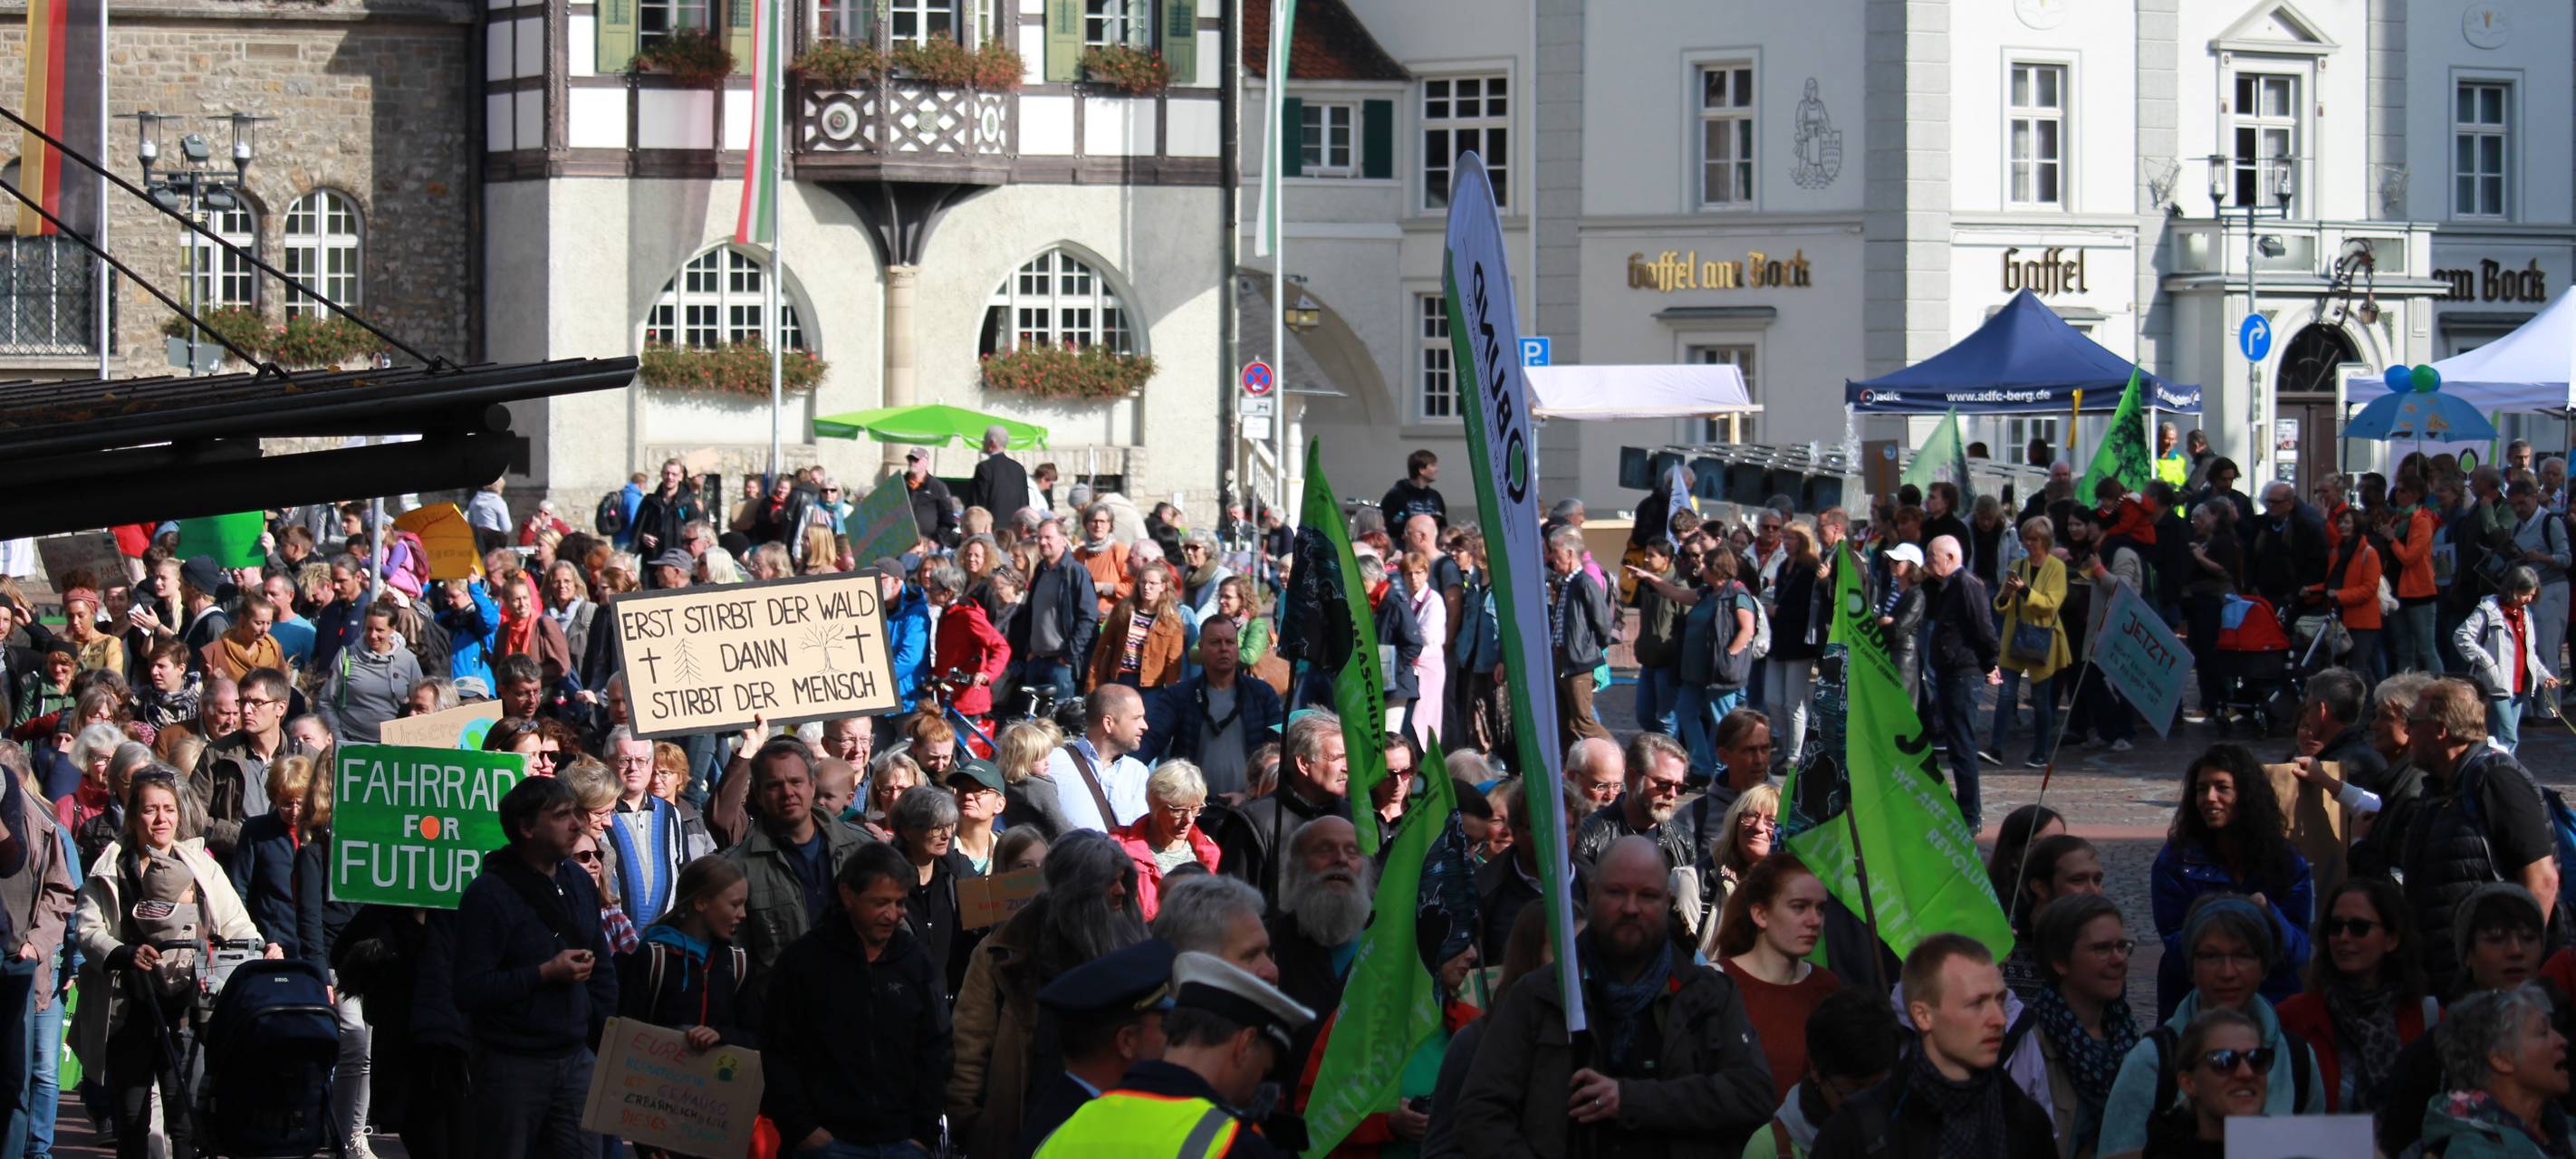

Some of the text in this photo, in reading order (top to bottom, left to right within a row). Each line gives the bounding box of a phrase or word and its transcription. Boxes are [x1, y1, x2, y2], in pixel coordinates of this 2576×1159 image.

[1628, 248, 1812, 292] Gaffel am Bock
[2000, 246, 2089, 297] Gaffel
[2480, 257, 2547, 302] Bock
[1524, 341, 1543, 366] P
[1876, 392, 1901, 401] adfc
[1946, 389, 2052, 403] www.adfc-berg.de
[621, 589, 875, 642] ERST STIRBT DER WALD
[720, 637, 789, 673] DANN
[2122, 609, 2177, 675] JETZT!
[651, 671, 878, 719] STIRBT DER MENSCH
[343, 759, 516, 811] FAHRRAD
[404, 815, 460, 840] FOR
[341, 840, 487, 893] FUTUR
[631, 1032, 687, 1066] EURE
